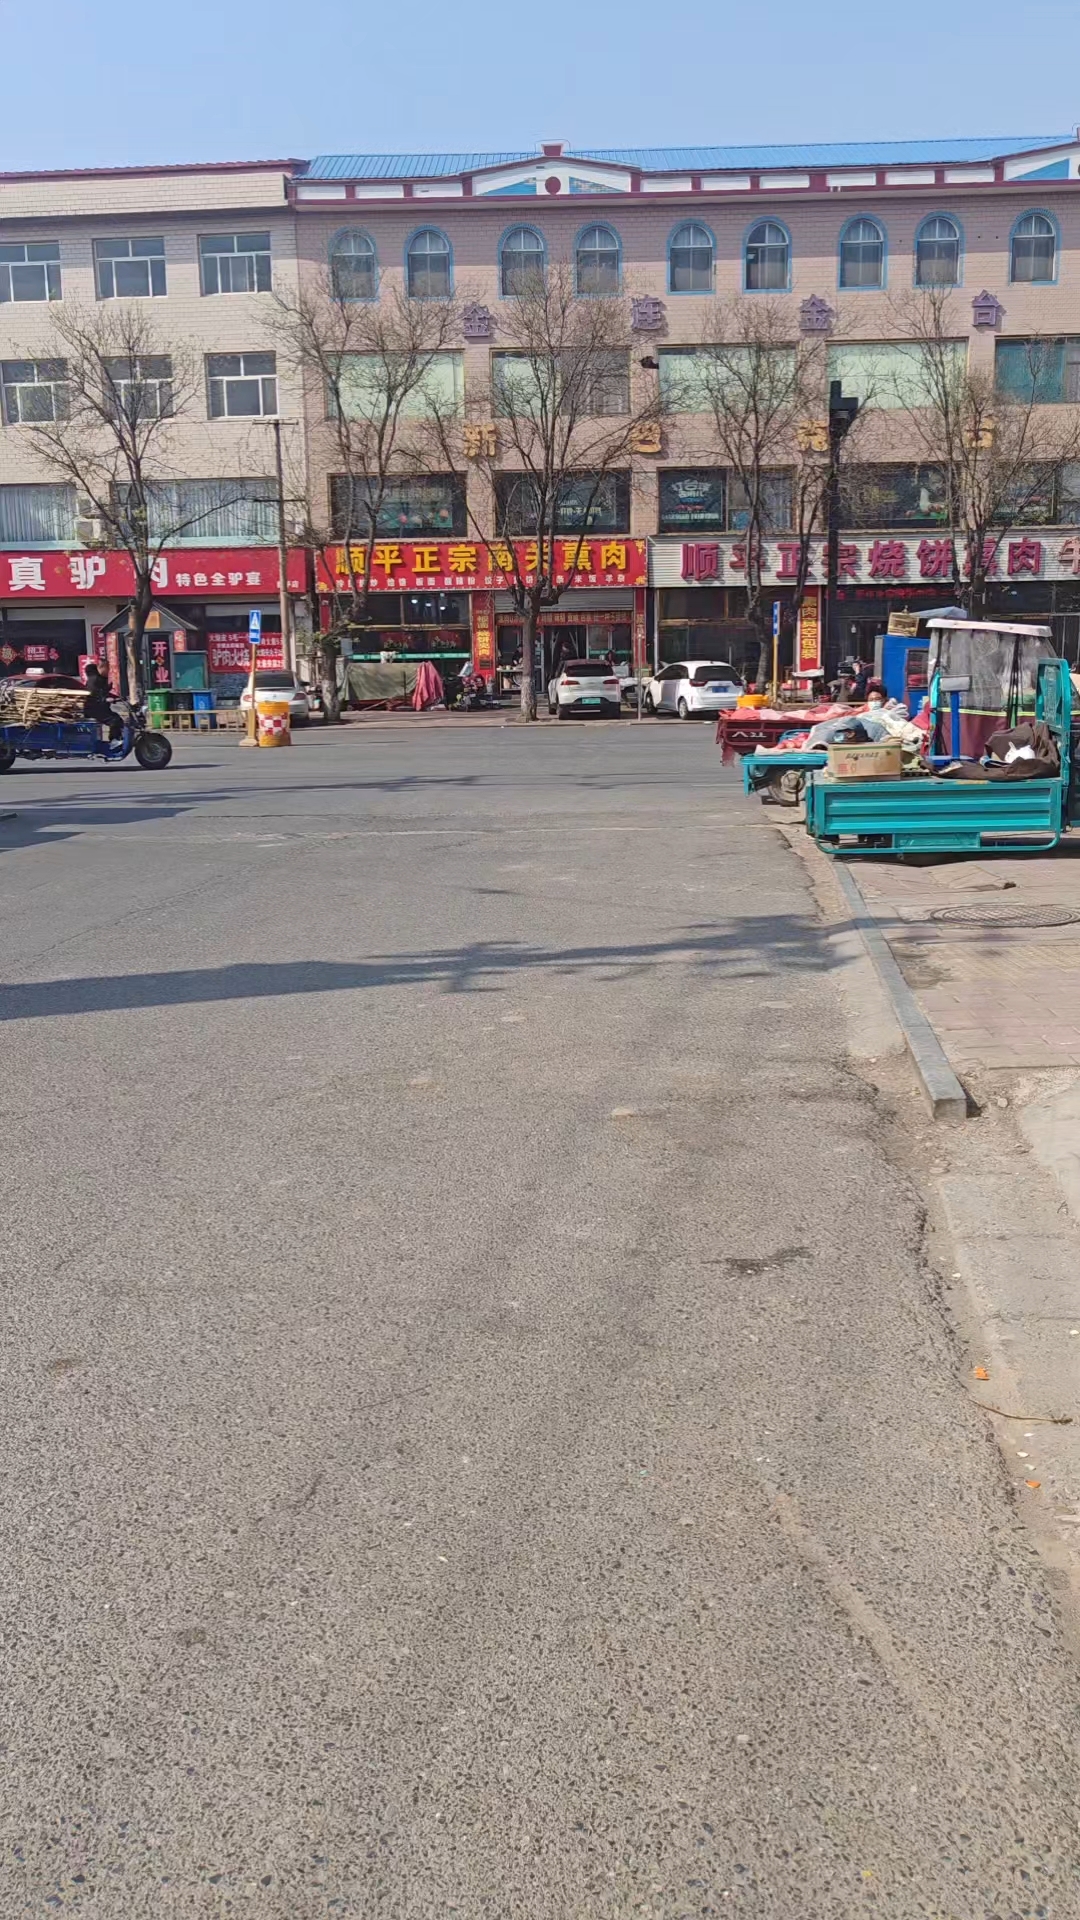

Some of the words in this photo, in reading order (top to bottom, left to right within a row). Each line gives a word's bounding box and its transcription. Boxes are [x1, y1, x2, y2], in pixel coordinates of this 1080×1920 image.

[335, 541, 626, 575] 顺平正宗南关熏肉
[575, 575, 597, 584] 米饭
[151, 641, 171, 683] 开业
